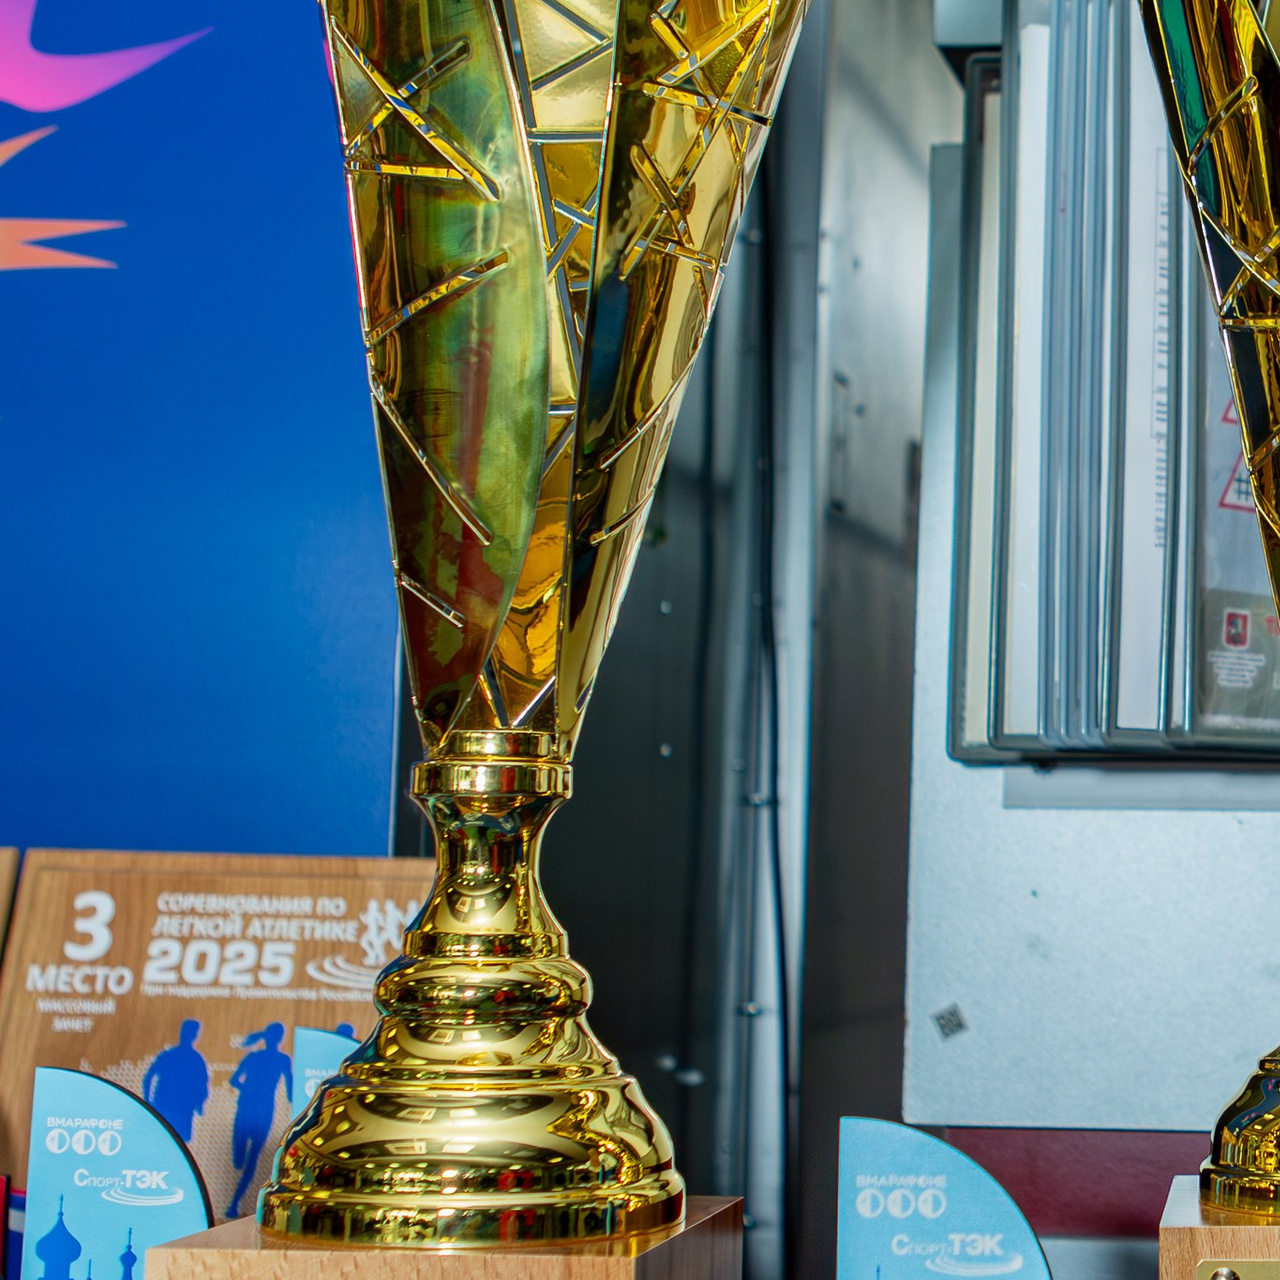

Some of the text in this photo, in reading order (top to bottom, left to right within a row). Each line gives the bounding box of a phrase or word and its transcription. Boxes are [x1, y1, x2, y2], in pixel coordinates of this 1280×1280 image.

[157, 892, 347, 917] СОРЕВНОВАНИЯ ПО
[64, 891, 115, 961] 3
[152, 913, 360, 942] ЛЕГКОЙ АТЛЕТИКЕ
[143, 937, 296, 987] 2025
[26, 965, 133, 995] МЕСТО
[74, 1168, 169, 1190] Спорт-ТЭК
[891, 1233, 1003, 1257] Спорт-ТЭК
